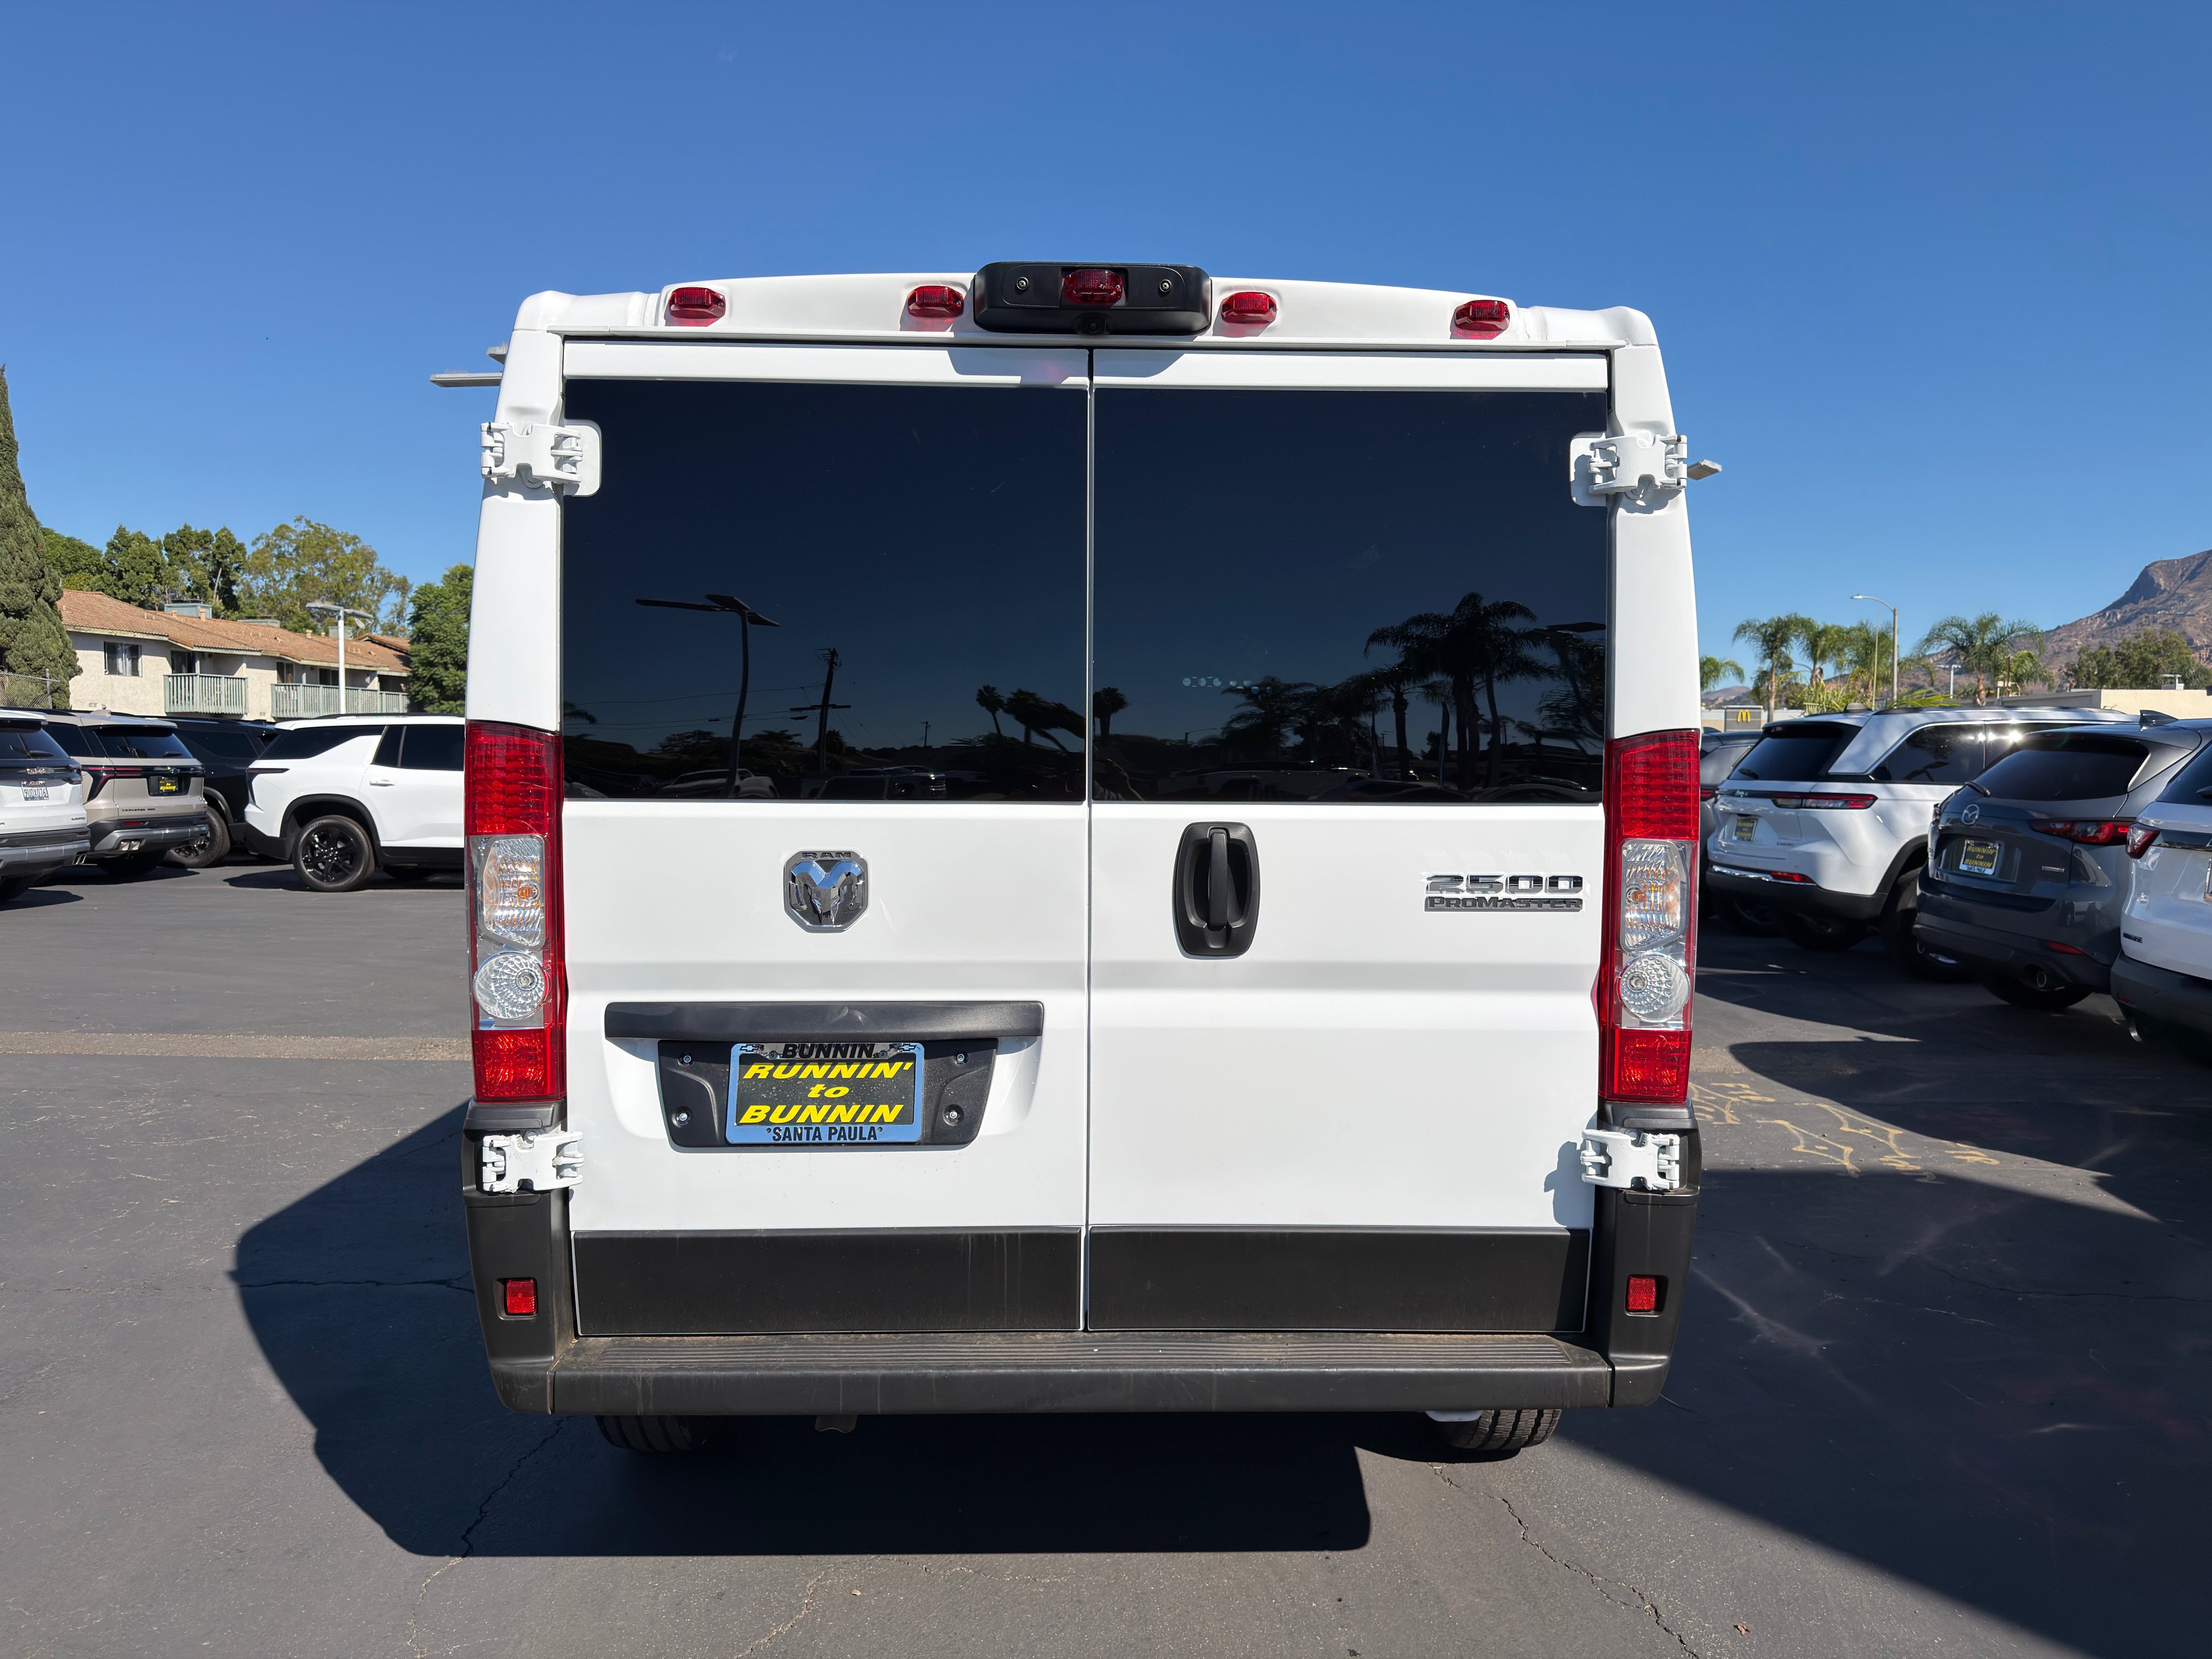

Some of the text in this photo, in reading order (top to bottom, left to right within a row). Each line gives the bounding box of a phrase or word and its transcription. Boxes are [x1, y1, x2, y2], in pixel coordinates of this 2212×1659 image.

[1963, 859, 1993, 868] BUNNIN
[1426, 874, 1583, 894] 2500
[782, 1043, 875, 1058] BUNNIN
[742, 1062, 913, 1079] RUNNIN'
[807, 1084, 850, 1098] to
[739, 1104, 904, 1124] BUNNIN
[772, 1126, 878, 1142] SANTA PAULA
